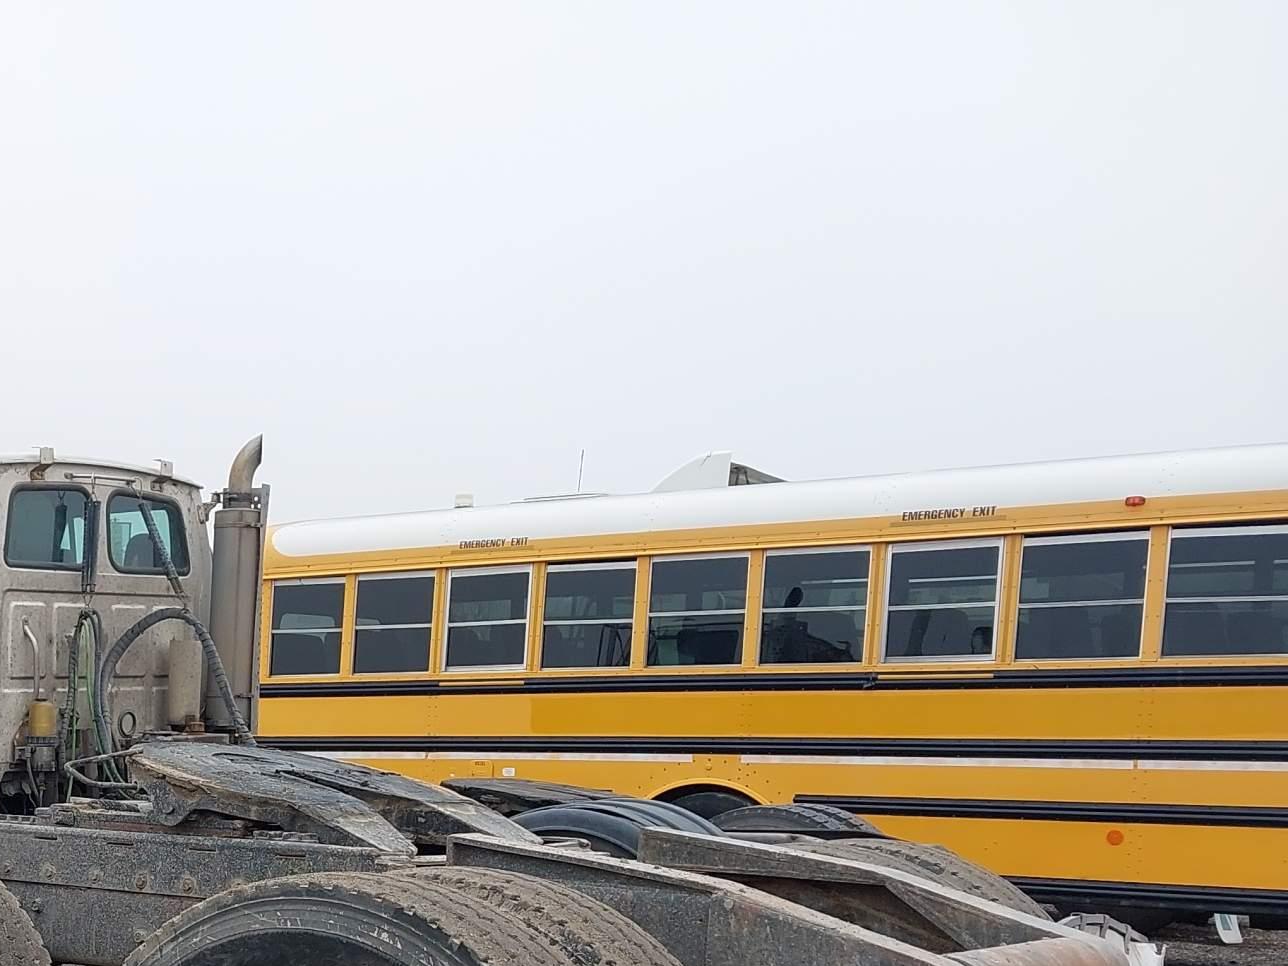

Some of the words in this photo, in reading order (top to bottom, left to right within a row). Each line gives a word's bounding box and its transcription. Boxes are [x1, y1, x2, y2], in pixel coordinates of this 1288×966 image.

[902, 508, 966, 521] EMERGENCY
[972, 505, 997, 517] EXIT
[459, 538, 506, 549] EMERGENCY
[510, 536, 529, 546] EXIT
